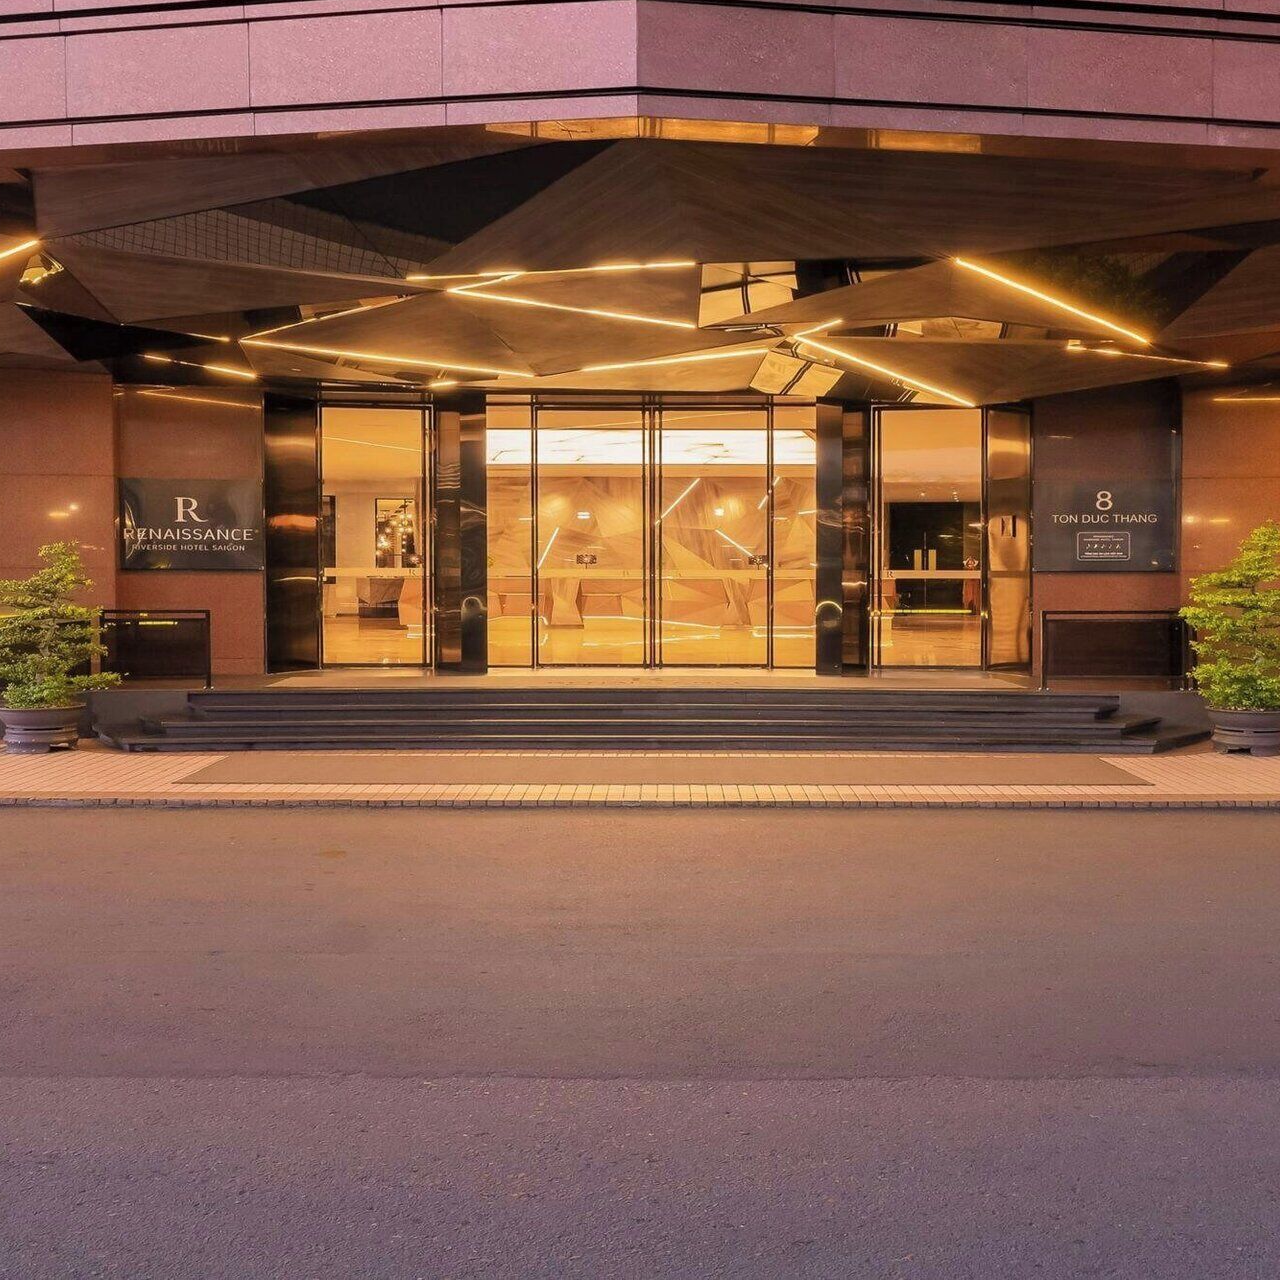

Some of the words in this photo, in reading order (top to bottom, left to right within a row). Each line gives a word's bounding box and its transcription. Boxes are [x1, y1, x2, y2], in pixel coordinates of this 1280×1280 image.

[1095, 490, 1113, 511] 8
[173, 496, 209, 522] R
[1051, 514, 1078, 524] TON
[1081, 514, 1110, 524] DUC
[1113, 513, 1158, 523] THANG
[123, 528, 254, 541] RENAISSANCE
[132, 543, 177, 551] RIVERSIDE
